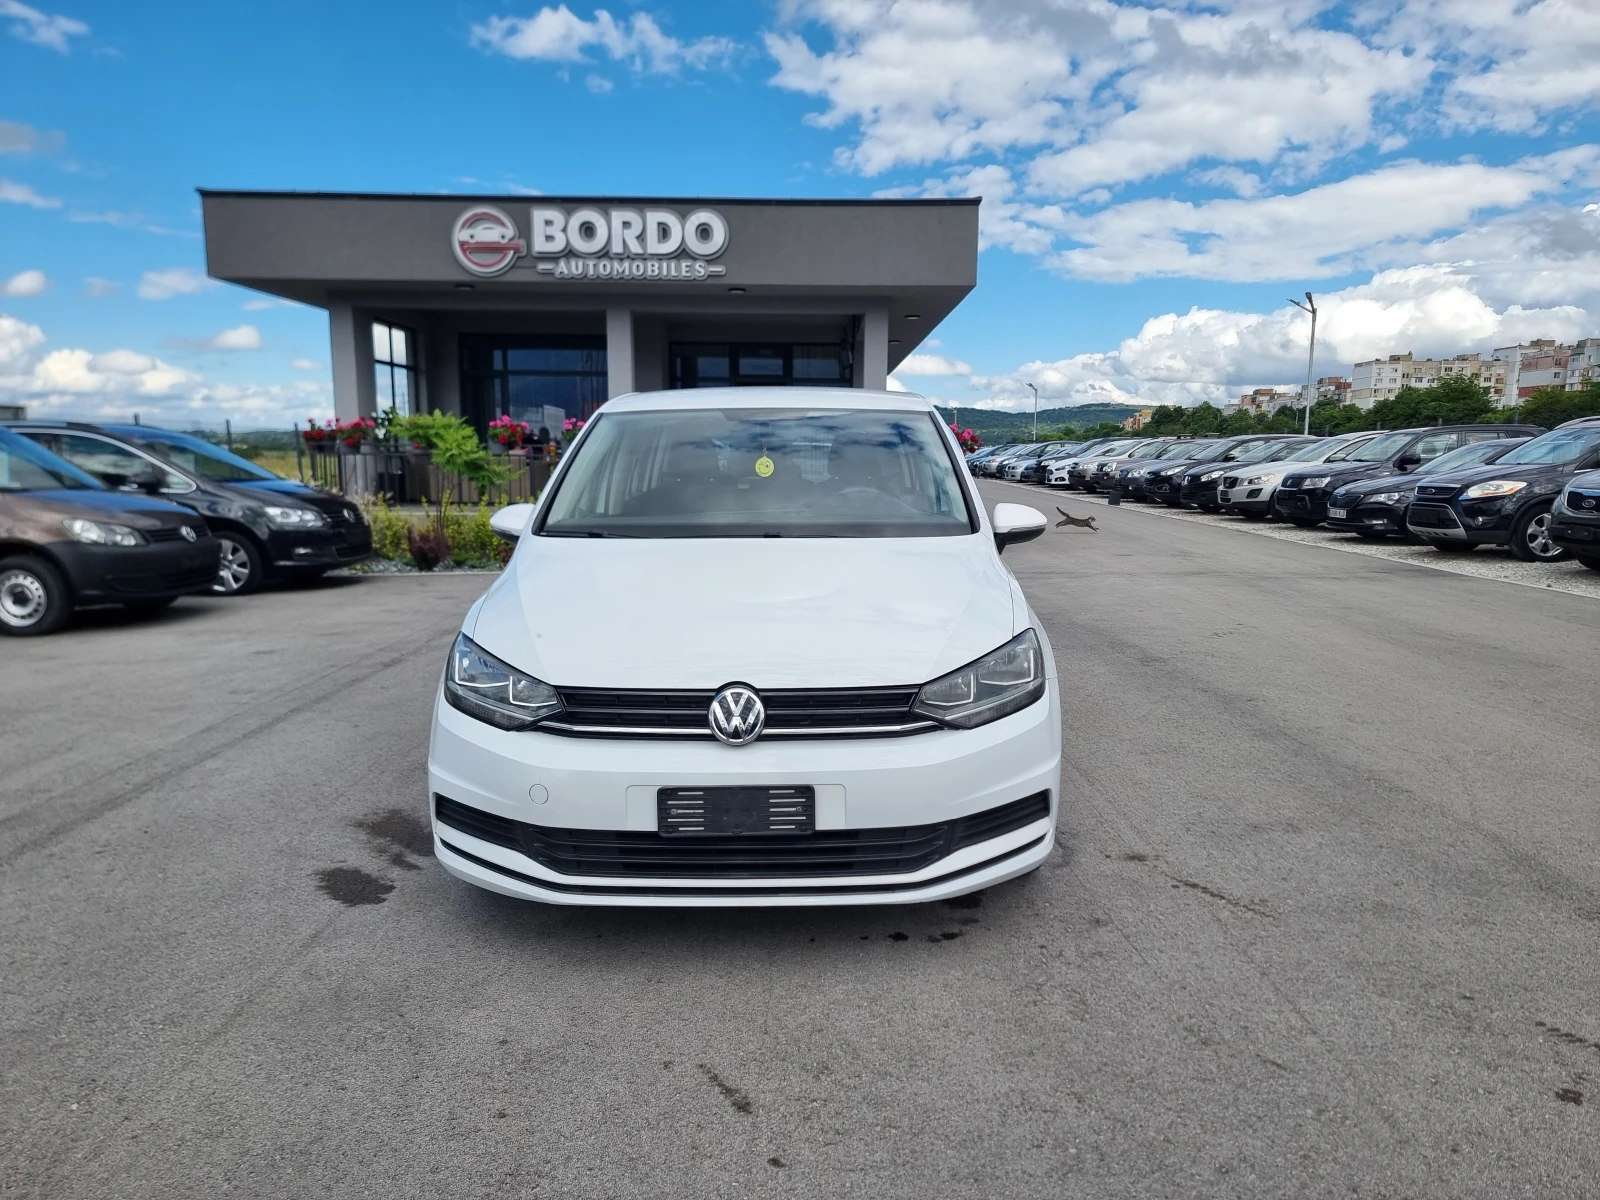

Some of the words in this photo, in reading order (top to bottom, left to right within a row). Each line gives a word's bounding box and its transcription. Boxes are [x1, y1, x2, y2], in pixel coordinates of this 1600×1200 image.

[532, 209, 726, 256] BORDO
[554, 260, 706, 277] AUTOMOBILES
[710, 689, 764, 743] VW
